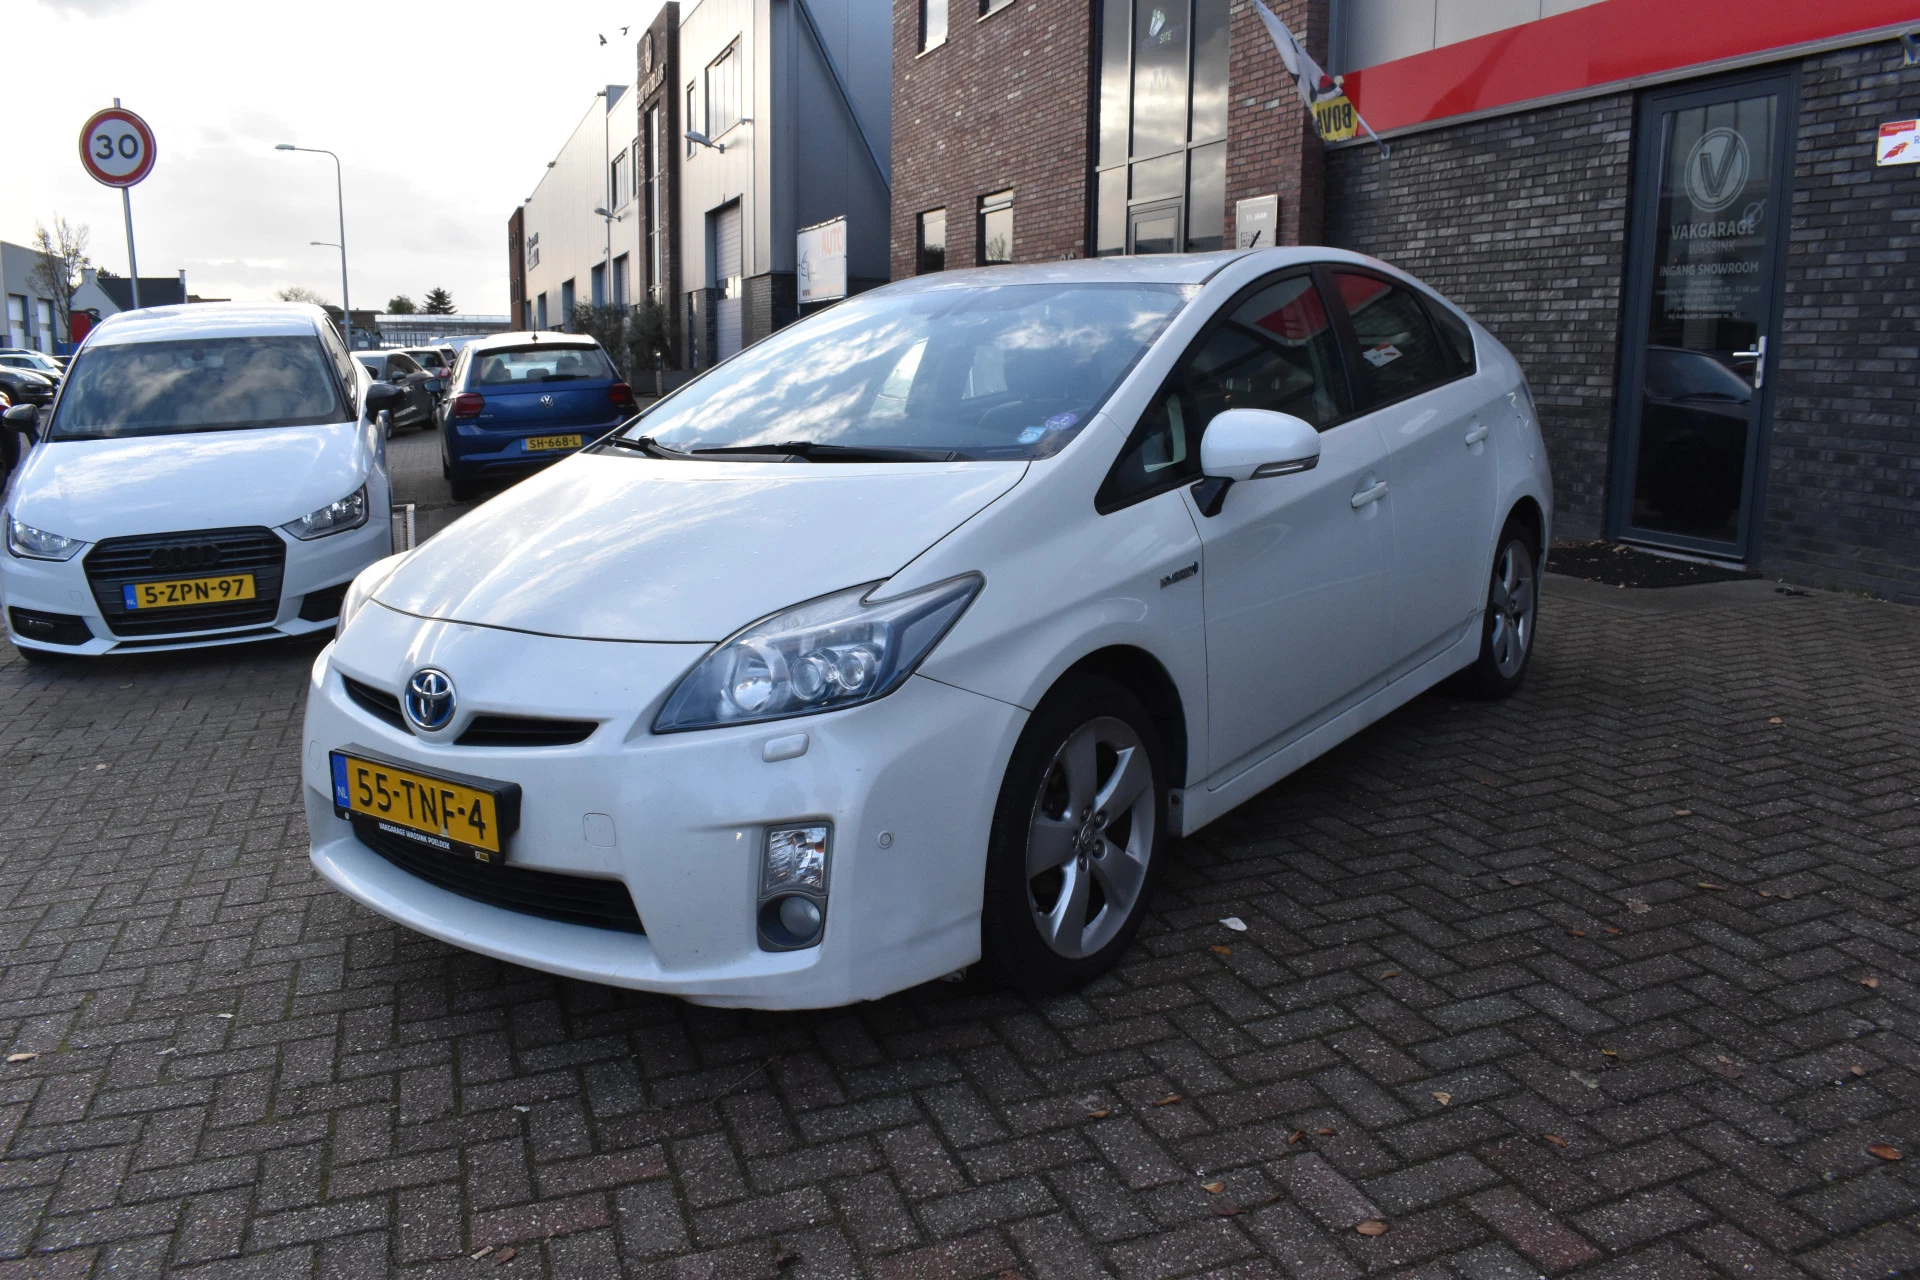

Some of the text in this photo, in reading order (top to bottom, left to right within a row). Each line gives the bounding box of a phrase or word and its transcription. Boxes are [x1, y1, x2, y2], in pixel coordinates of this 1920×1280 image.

[95, 134, 139, 160] 30
[1671, 220, 1755, 240] VAKGARAGE
[822, 226, 844, 256] AUTO
[1689, 240, 1736, 254] WASSINK
[1660, 261, 1759, 276] INGANG SHOWROOM
[529, 437, 579, 449] SH-668-L
[145, 578, 244, 604] 5-ZPN-97
[337, 785, 348, 799] NL
[357, 768, 486, 839] 55-TNF-4
[378, 822, 406, 837] VAKGARAGE
[406, 830, 428, 843] WASSINK
